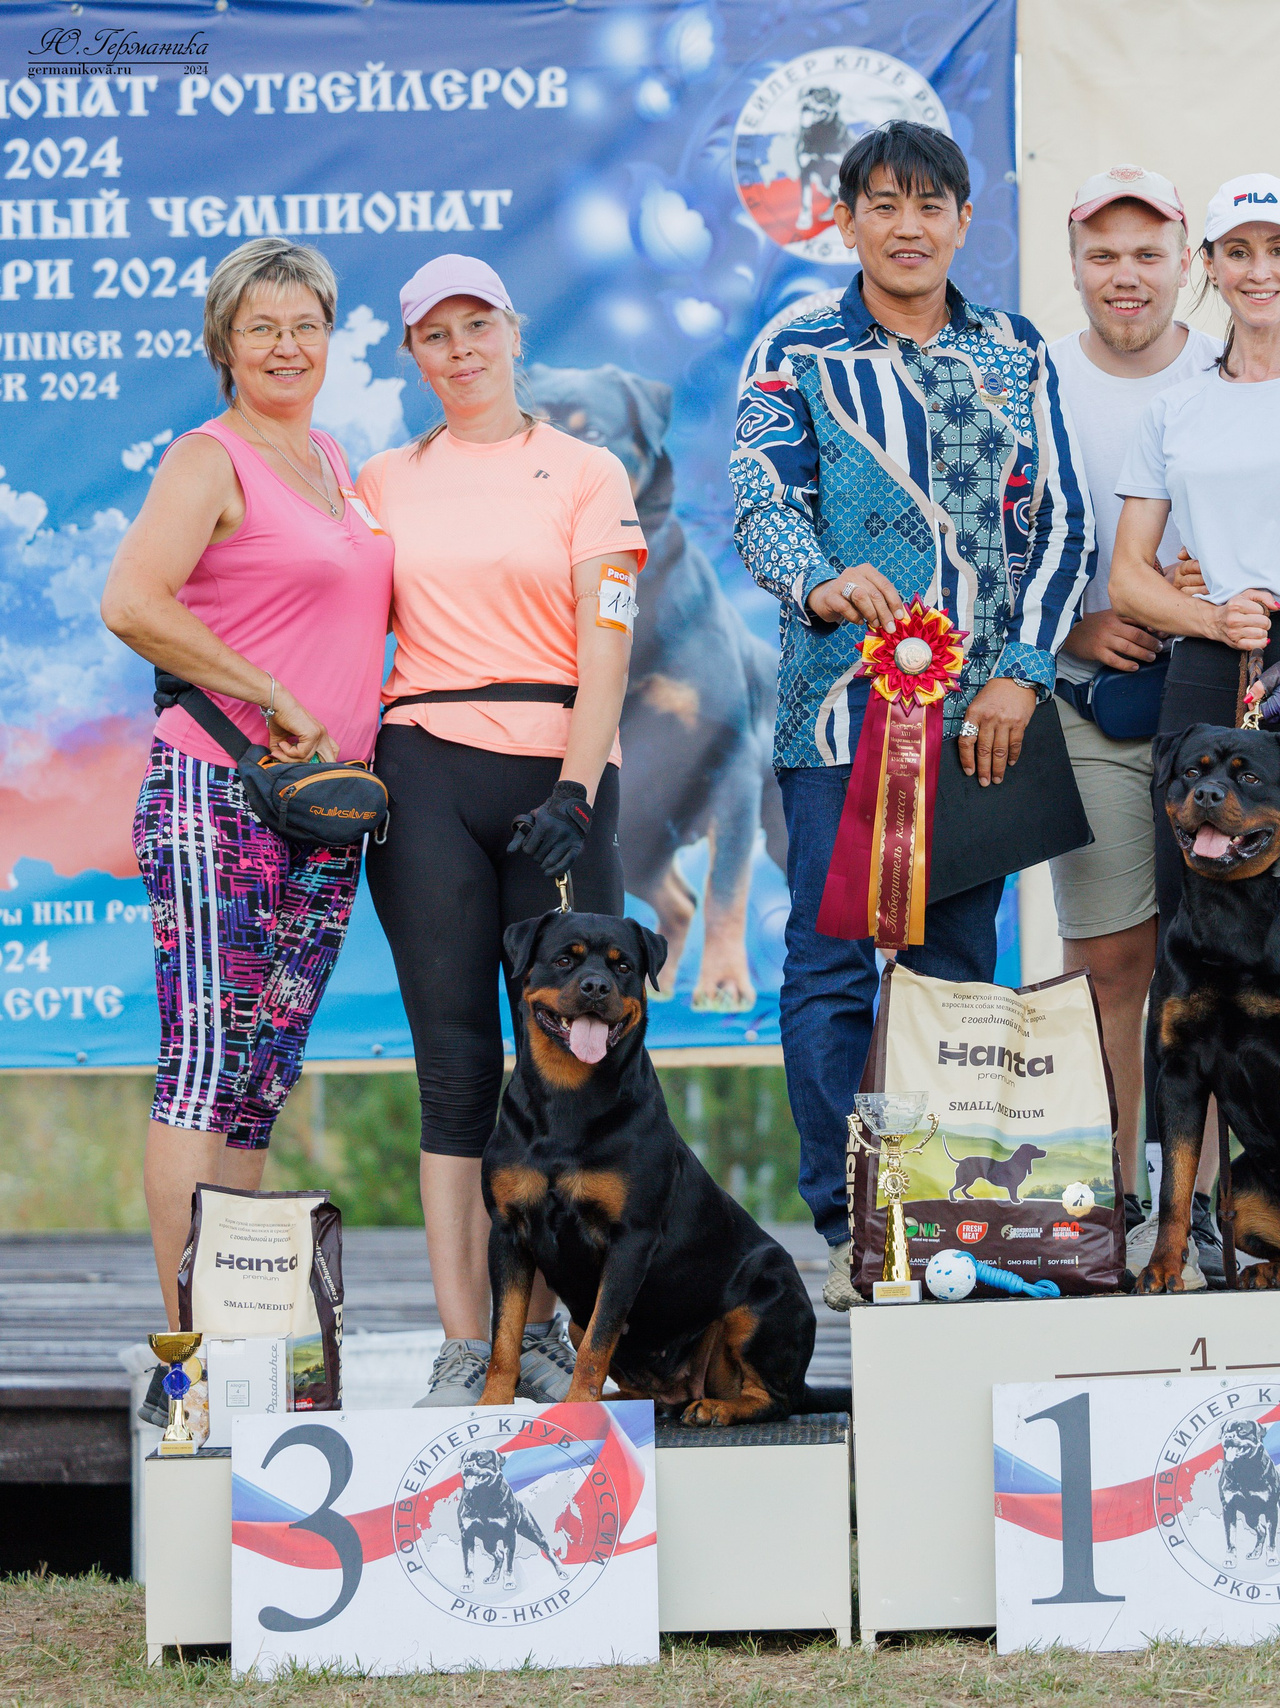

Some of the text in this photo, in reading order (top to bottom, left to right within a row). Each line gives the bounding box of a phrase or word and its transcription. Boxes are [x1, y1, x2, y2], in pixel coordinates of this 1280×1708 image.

[834, 54, 908, 87] КЛУБ
[176, 61, 569, 117] РОТВЕЙЛЕРОВ
[3, 135, 123, 180] 2024
[147, 189, 513, 238] ЧЕМПИОНАТ
[1233, 191, 1278, 207] FILA
[92, 255, 212, 299] 2024
[0, 329, 124, 362] INNER
[0, 370, 121, 403] R 2024
[895, 789, 907, 839] класса
[32, 900, 95, 926] НКП
[0, 939, 52, 973] 24
[0, 984, 124, 1021] ЕСТЕ
[953, 992, 972, 1001] Корм
[972, 993, 993, 1002] сухой
[968, 1014, 1014, 1029] говядиной
[938, 1040, 1054, 1078] Hanta
[948, 1100, 1045, 1119] SMALL/MEDIUM
[919, 1222, 940, 1237] NWC
[962, 1224, 982, 1233] FRESH
[962, 1232, 978, 1240] MEAT
[215, 1251, 298, 1273] Hanta
[242, 1274, 280, 1282] premium
[1190, 1337, 1217, 1371] 1
[1158, 1392, 1241, 1549] РОТВЕЙЛЕР
[396, 1417, 618, 1575] РОТВЕЙЛЕР КЛУБ РОССИИ
[1023, 1392, 1126, 1605] 1
[257, 1423, 363, 1632] 3
[450, 1588, 573, 1624] РКФ-НКПР
